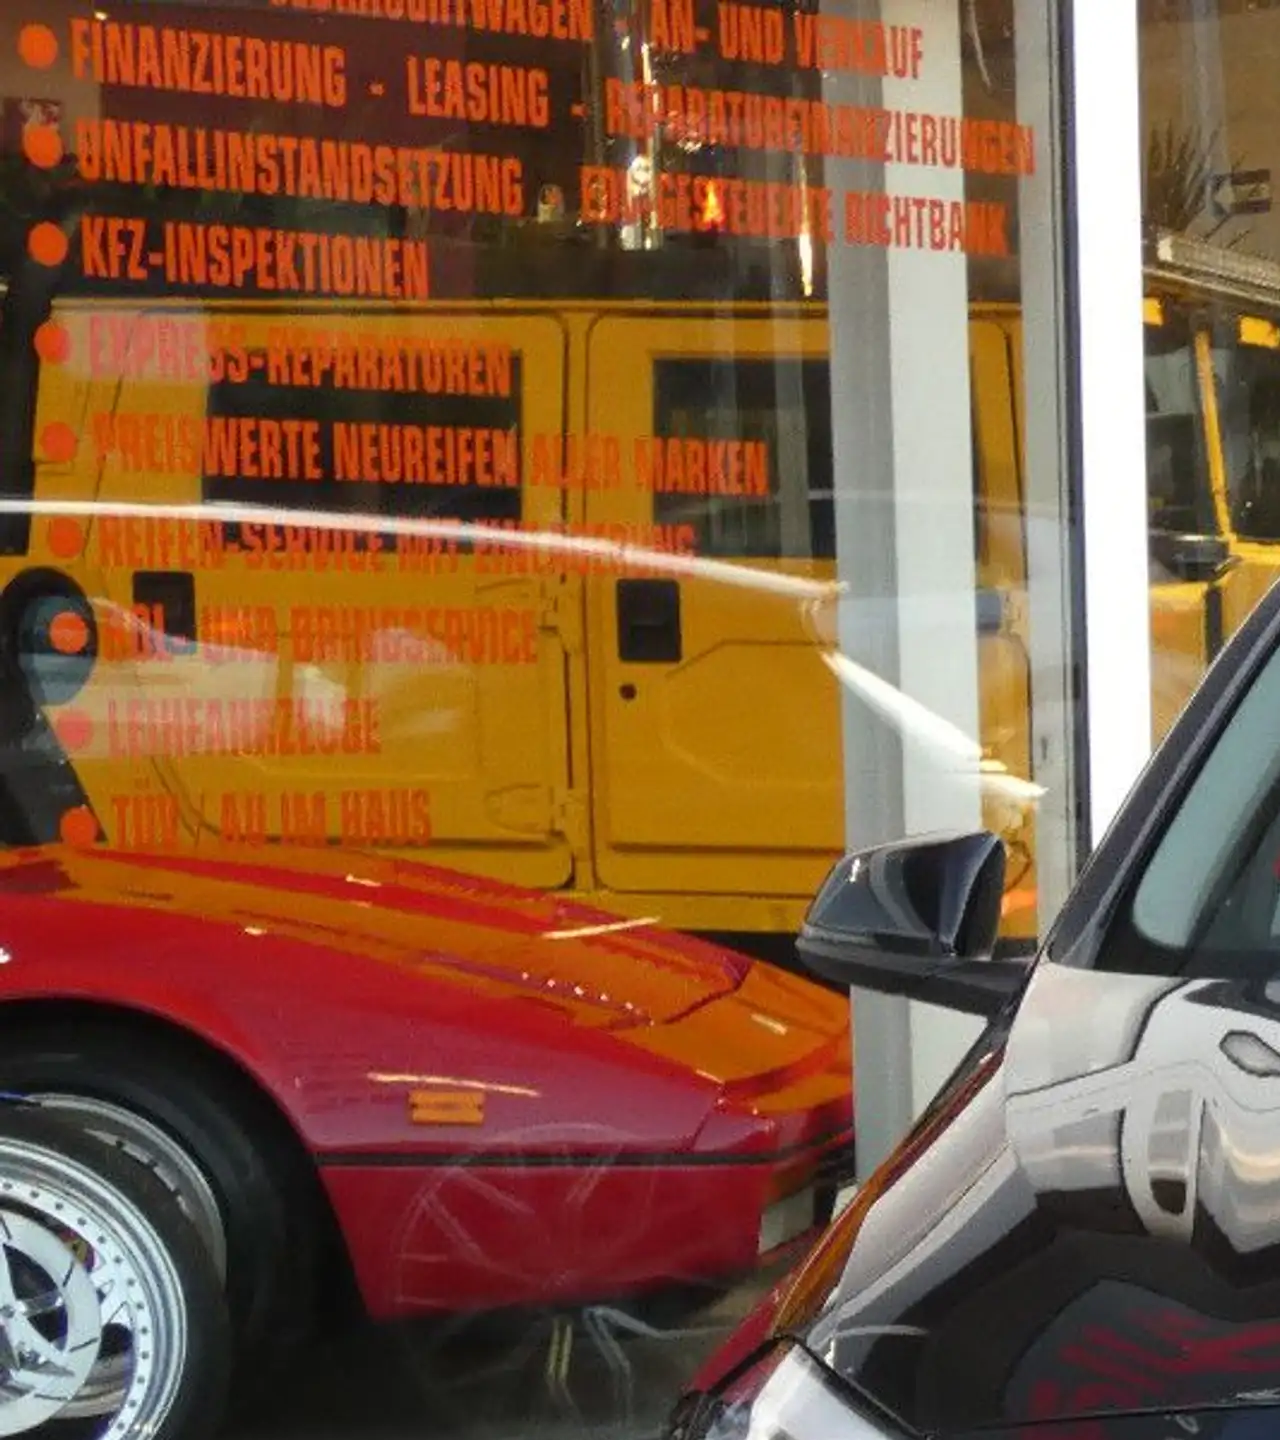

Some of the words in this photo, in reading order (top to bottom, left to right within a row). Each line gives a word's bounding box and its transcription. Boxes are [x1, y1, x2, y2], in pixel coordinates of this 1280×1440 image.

[70, 19, 347, 107] FINANZIERUNG
[407, 56, 549, 128] LEASING
[718, 3, 784, 64] UND
[75, 117, 523, 216] UNFALLINSTANDSETZUNG
[81, 216, 429, 300] KFZ-INSPEKTIONEN
[89, 314, 511, 396] EXPRESS-REPARATUREN
[92, 412, 322, 480] PREISWERTE
[333, 421, 518, 487] NEUREIFEN
[634, 436, 768, 496] MARKEN
